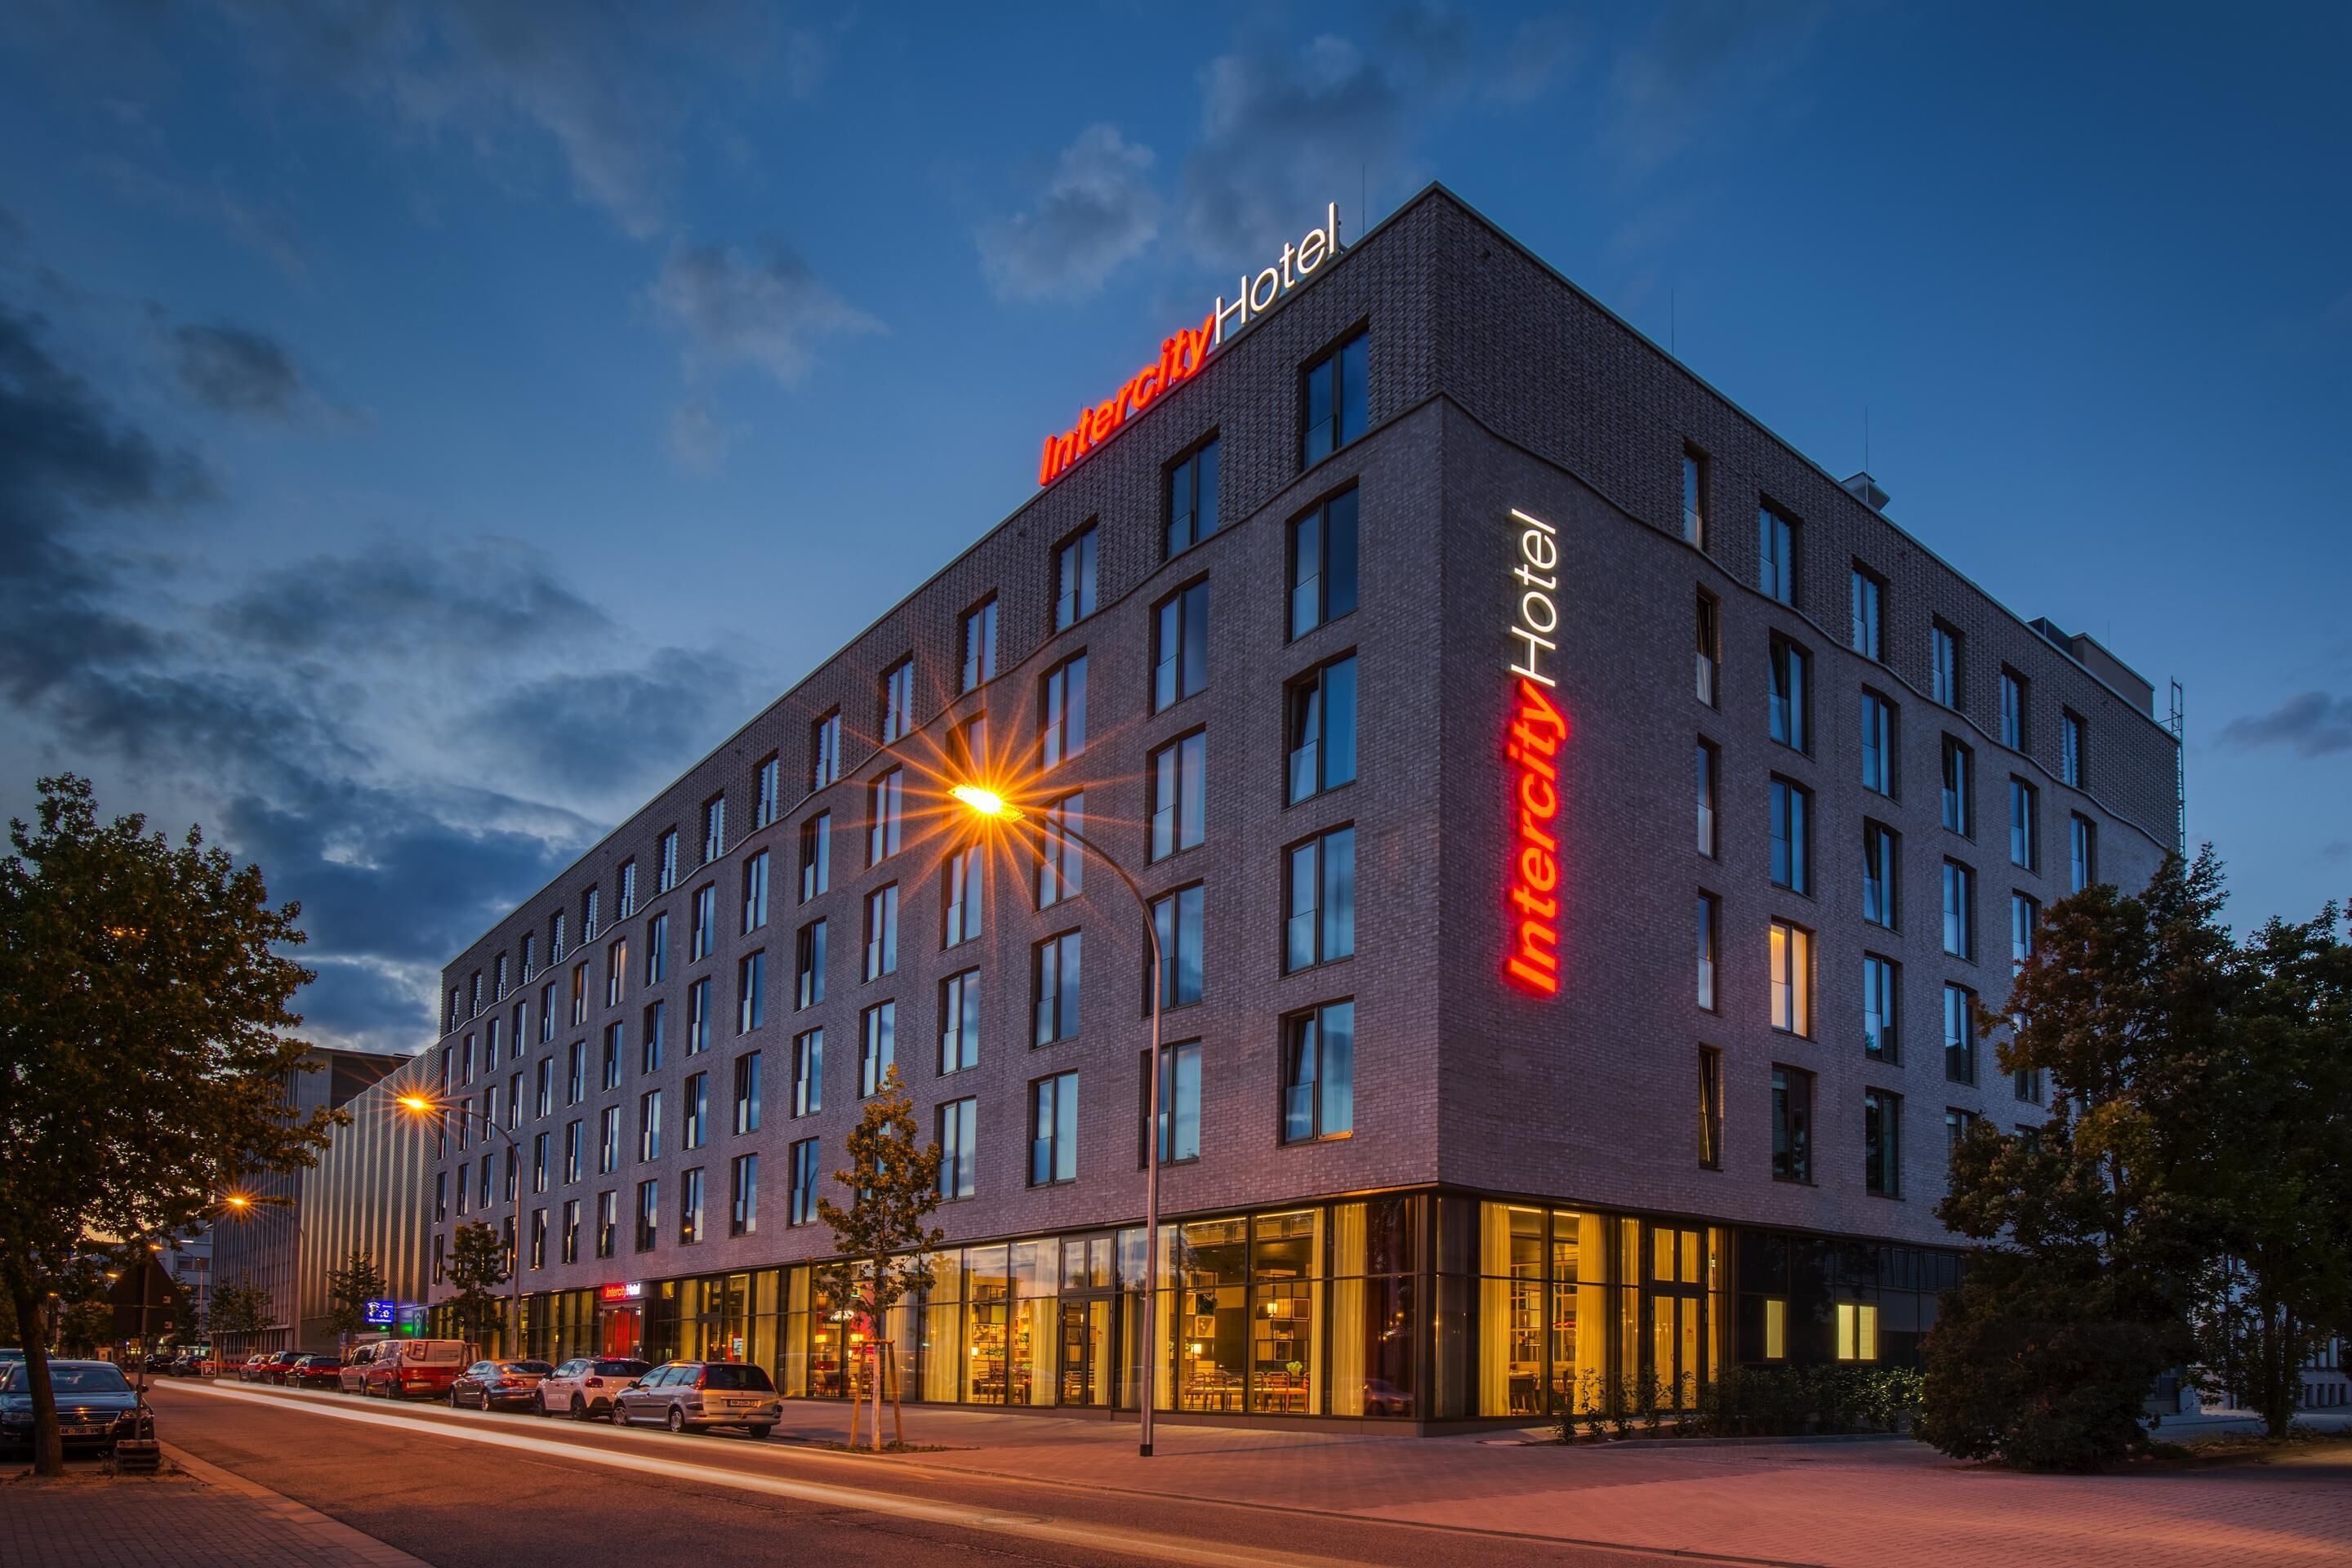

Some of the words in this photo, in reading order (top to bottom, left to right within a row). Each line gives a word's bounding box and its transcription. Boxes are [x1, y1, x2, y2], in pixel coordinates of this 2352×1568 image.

[1040, 202, 1339, 487] IntercityHotel
[1506, 507, 1566, 995] IntercityHotel
[604, 1283, 641, 1298] IntercityHotel
